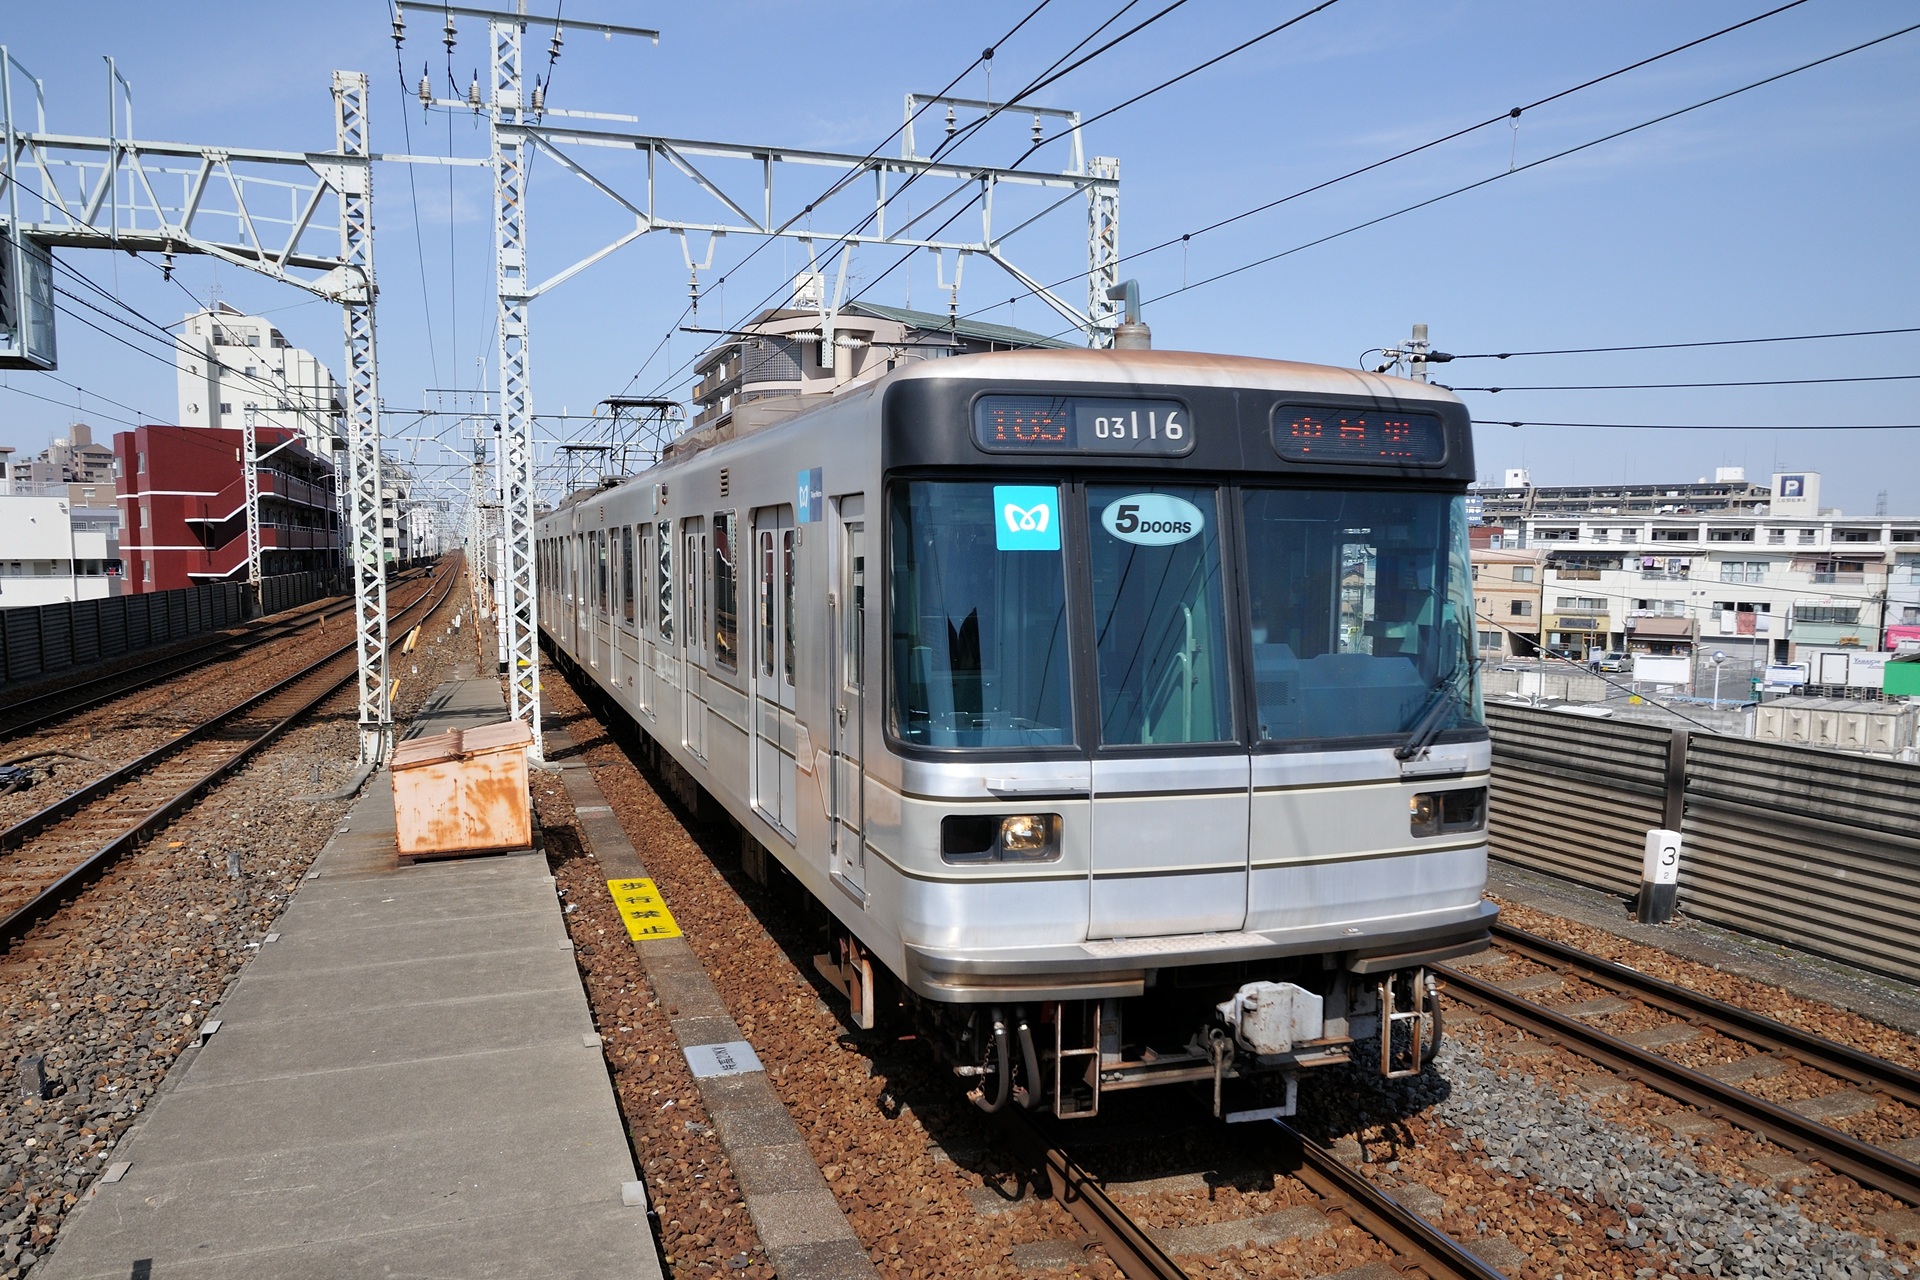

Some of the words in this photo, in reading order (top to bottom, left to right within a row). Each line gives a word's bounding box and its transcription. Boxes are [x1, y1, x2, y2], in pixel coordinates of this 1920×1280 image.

[1095, 411, 1183, 440] 03116
[1785, 480, 1799, 495] P
[1115, 504, 1140, 534] 5
[1140, 521, 1192, 533] DOORS
[1662, 847, 1676, 866] 3
[1663, 871, 1670, 880] 2
